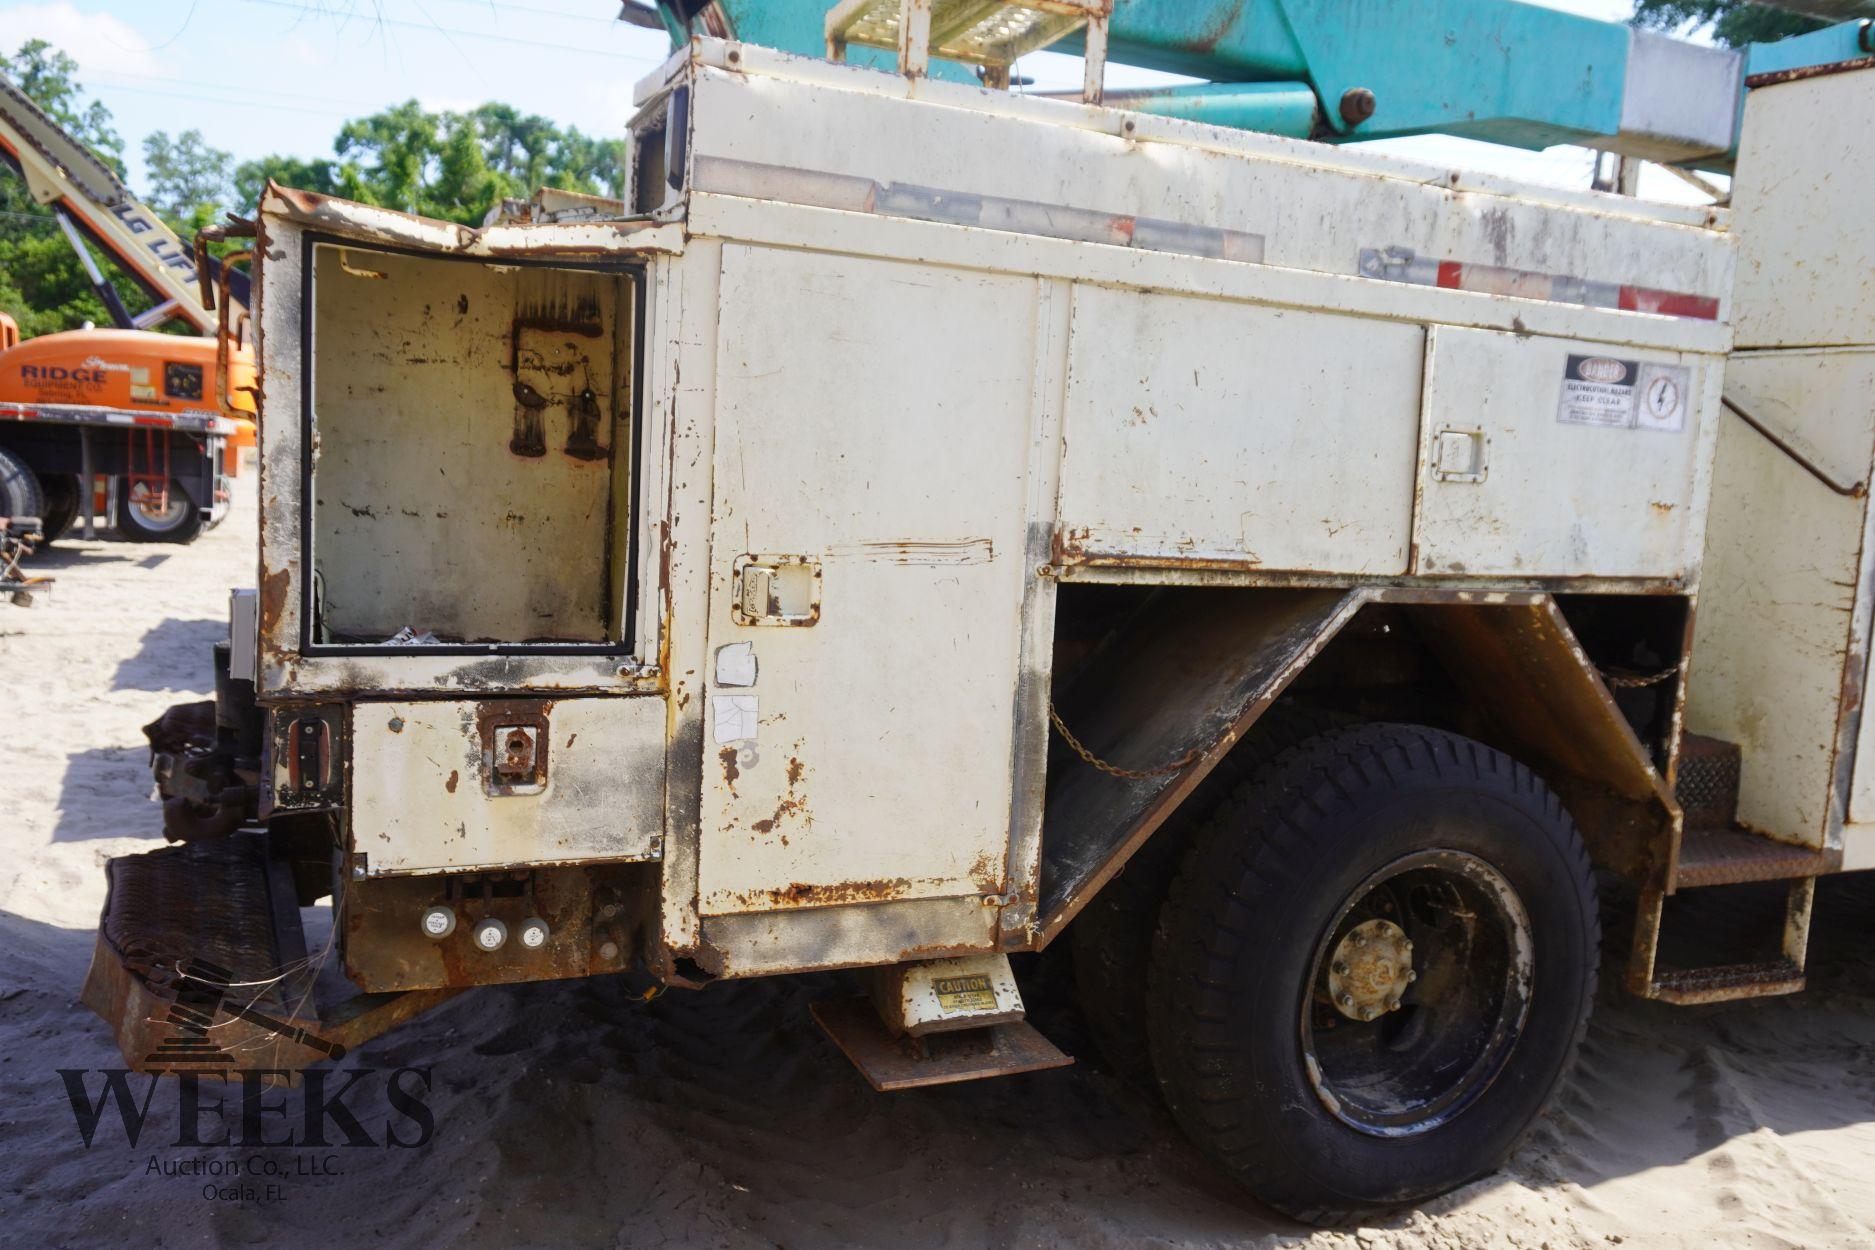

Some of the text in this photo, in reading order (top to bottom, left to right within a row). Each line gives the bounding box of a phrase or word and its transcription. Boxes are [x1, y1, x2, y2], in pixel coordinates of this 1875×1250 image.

[109, 203, 153, 234] LG
[21, 364, 107, 384] RIDGE
[1584, 361, 1621, 378] DANGER
[1576, 394, 1621, 406] KEEP CLEAR
[939, 978, 986, 993] CAUTION
